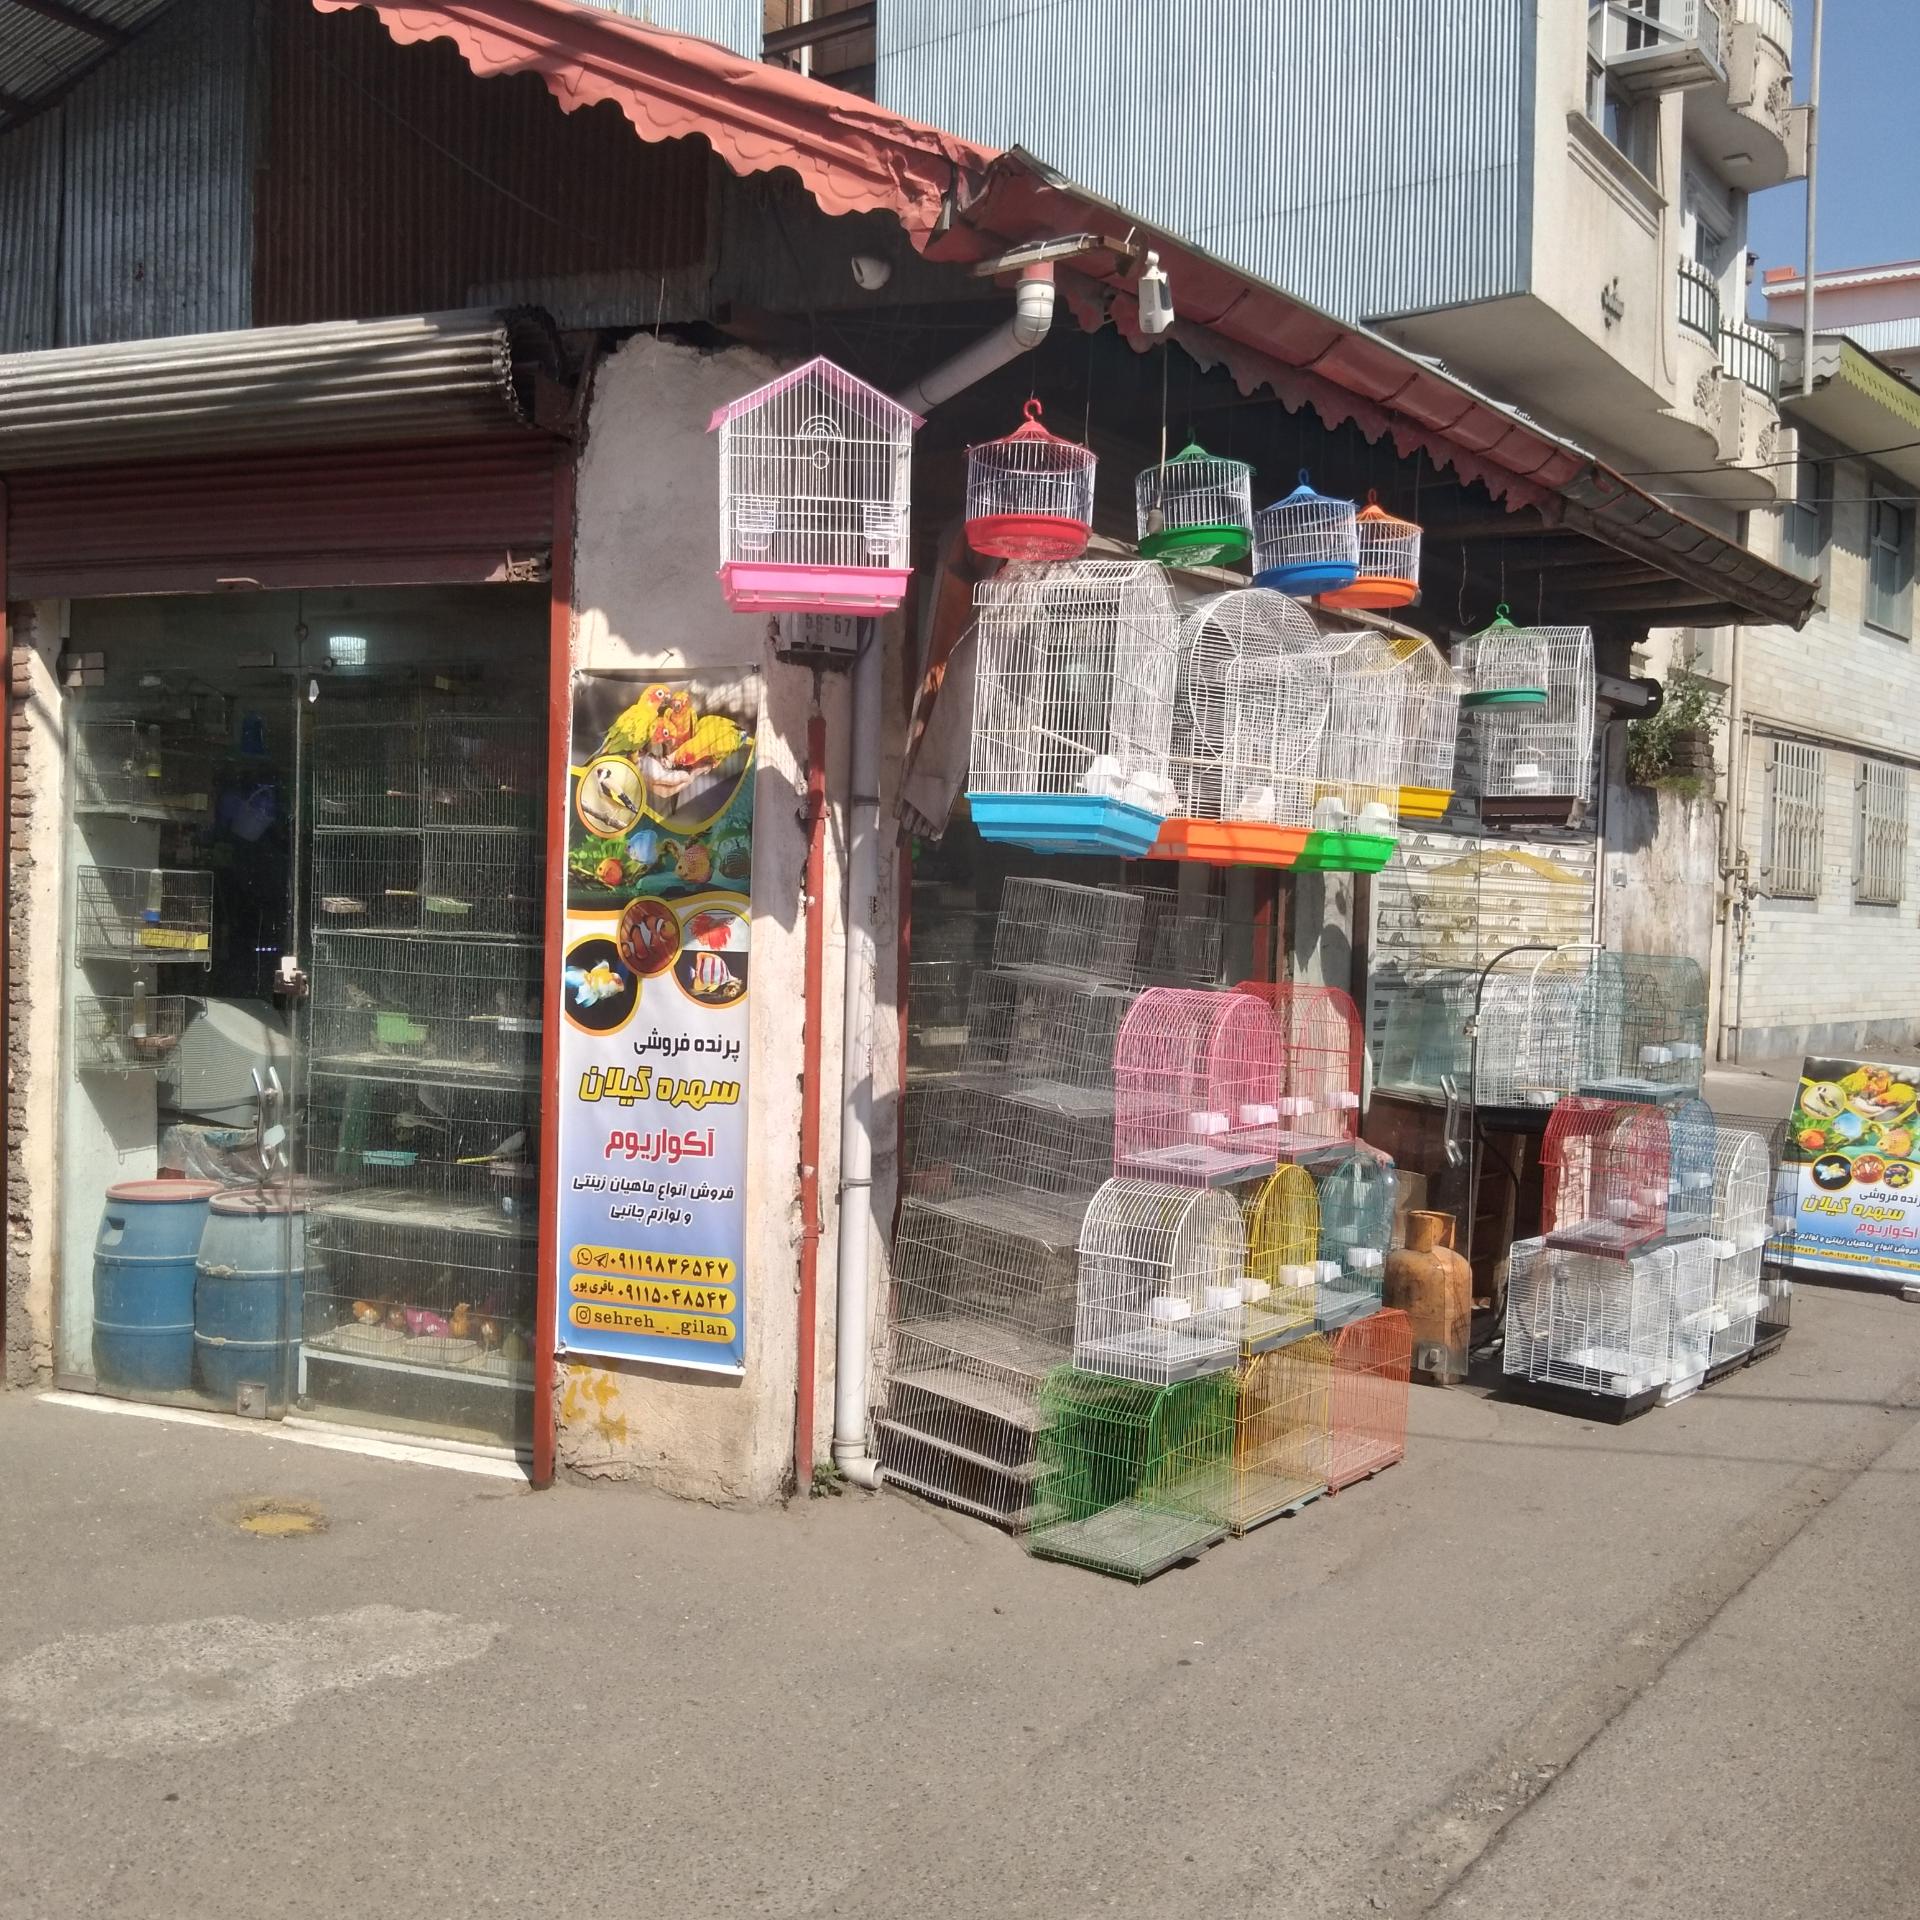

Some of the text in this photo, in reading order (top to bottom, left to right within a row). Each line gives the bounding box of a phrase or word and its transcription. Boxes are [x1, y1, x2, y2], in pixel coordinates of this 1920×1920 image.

[633, 1027, 741, 1062] پرنده فروشی
[578, 1065, 741, 1111] سهره گیلان
[604, 1128, 715, 1164] آکواریوم
[572, 1174, 735, 1201] فروش انواع ماهیان زینتی
[1859, 1187, 1899, 1204] فروشی
[610, 1204, 692, 1226] و لوازم جانبی
[1801, 1194, 1905, 1222] سهره گیلان
[1826, 1236, 1845, 1245] زینتی
[1846, 1240, 1873, 1249] ماهیان
[1875, 1243, 1892, 1252] انواع
[1893, 1244, 1918, 1255] فروش
[610, 1252, 729, 1279] ۰۹۱۱۹۸۳۶۵۴۷
[589, 1279, 614, 1296] باقری
[618, 1284, 728, 1310] ۰۹۱۱۵۰۴۸۵۴۲
[594, 1311, 729, 1337] sehreh_._gilan
